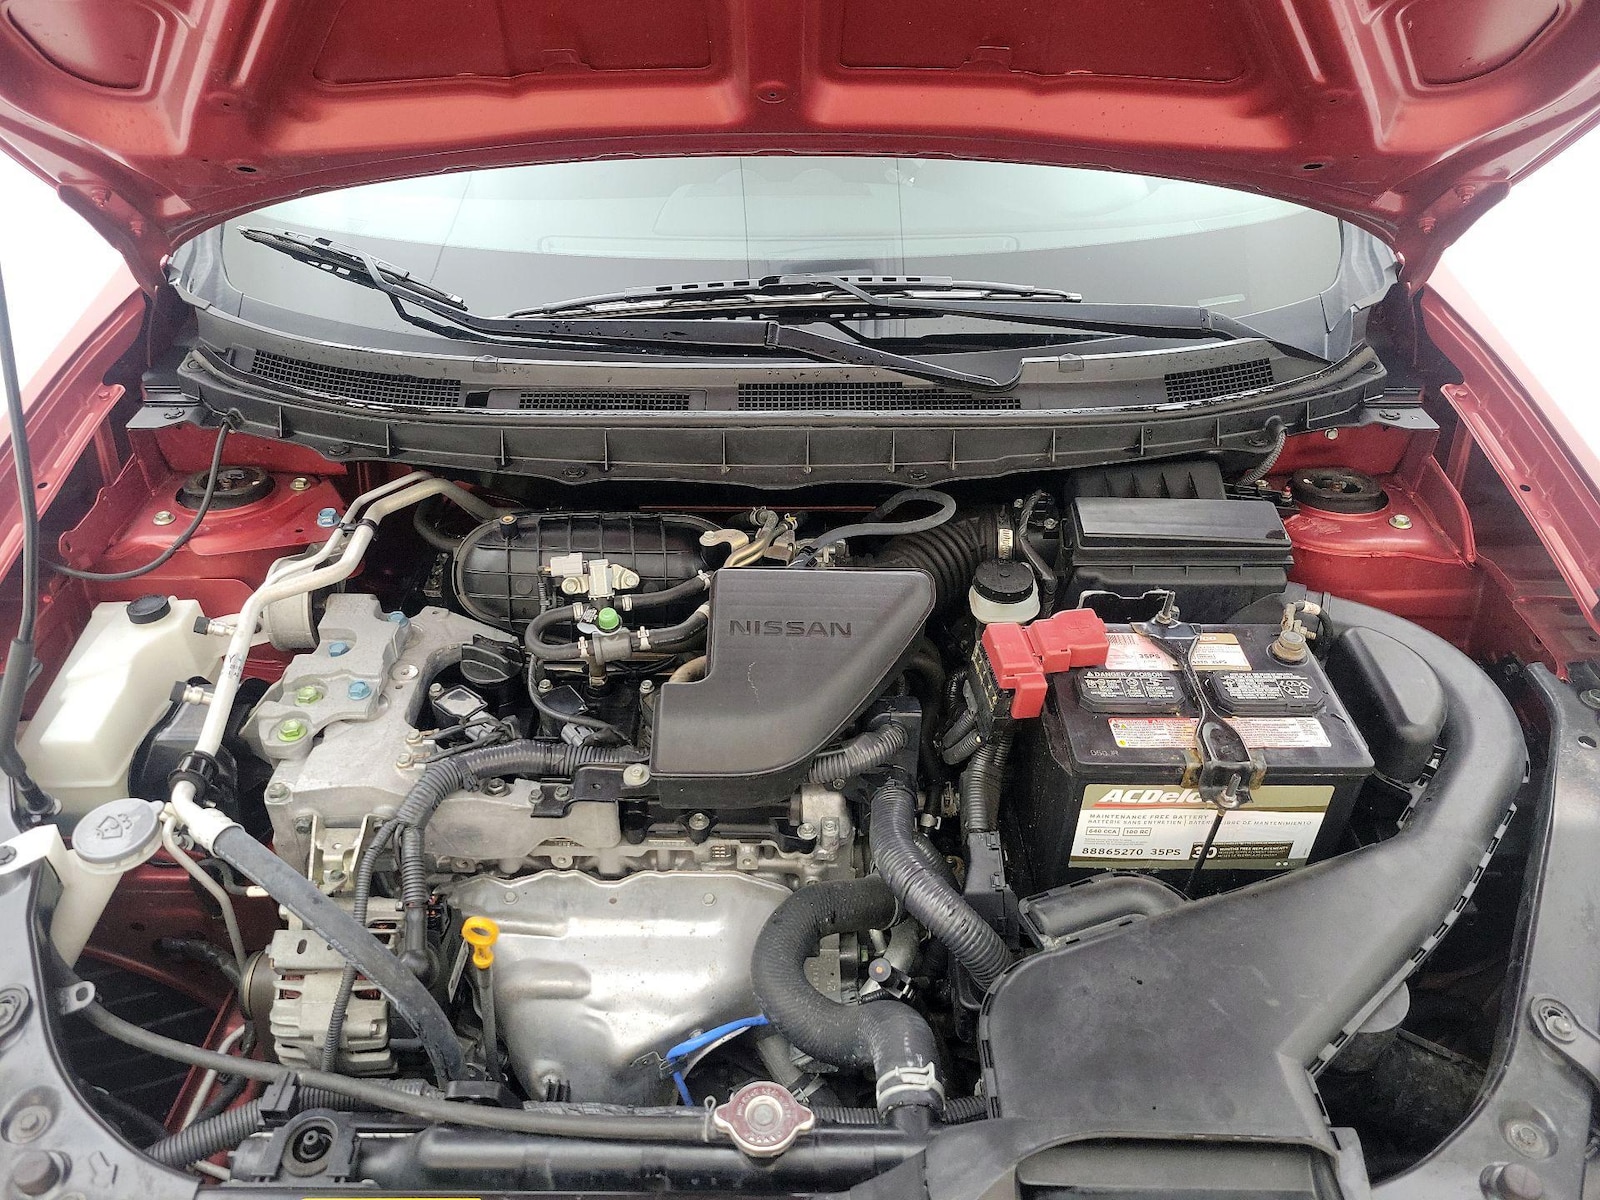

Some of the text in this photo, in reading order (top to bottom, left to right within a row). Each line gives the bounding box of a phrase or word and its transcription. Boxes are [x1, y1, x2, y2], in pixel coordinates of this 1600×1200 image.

[729, 620, 852, 639] NISSAN
[1098, 789, 1210, 803] ACDelc
[1081, 847, 1181, 856] 88865270 35PS
[1191, 846, 1218, 859] 30
